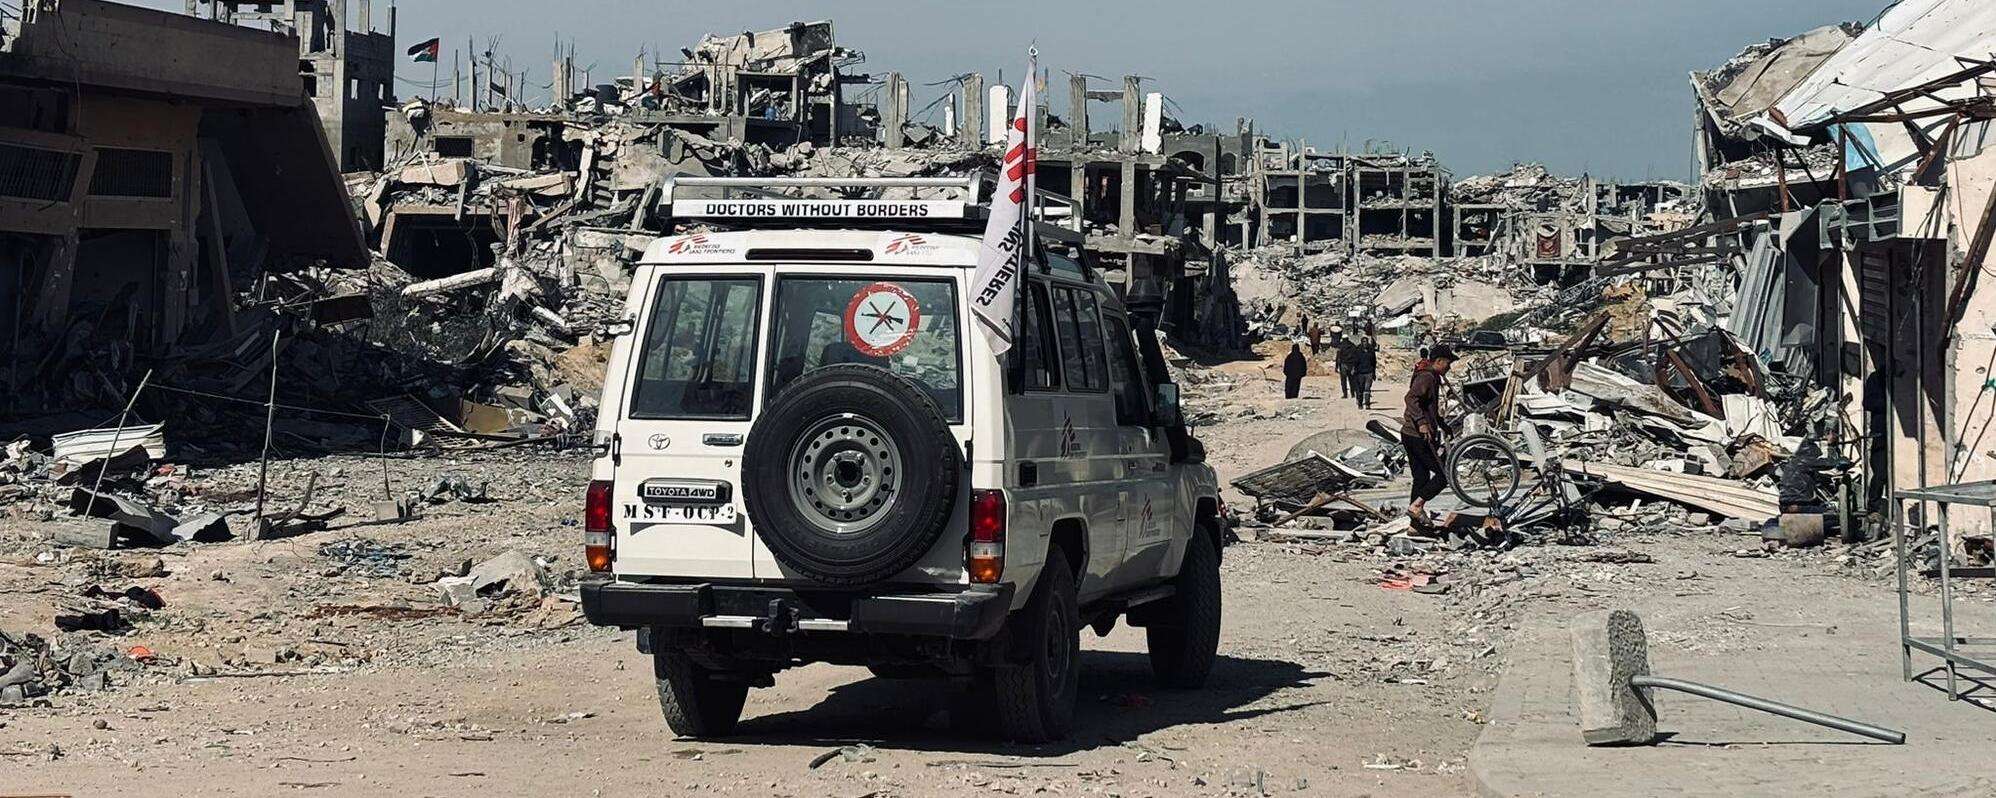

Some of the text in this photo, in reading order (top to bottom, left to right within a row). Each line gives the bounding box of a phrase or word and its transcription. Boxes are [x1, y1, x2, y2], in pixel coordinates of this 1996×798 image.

[706, 203, 929, 216] DOCTORS WITHOUT BORDERS
[648, 487, 715, 497] TOYOTA 4WD
